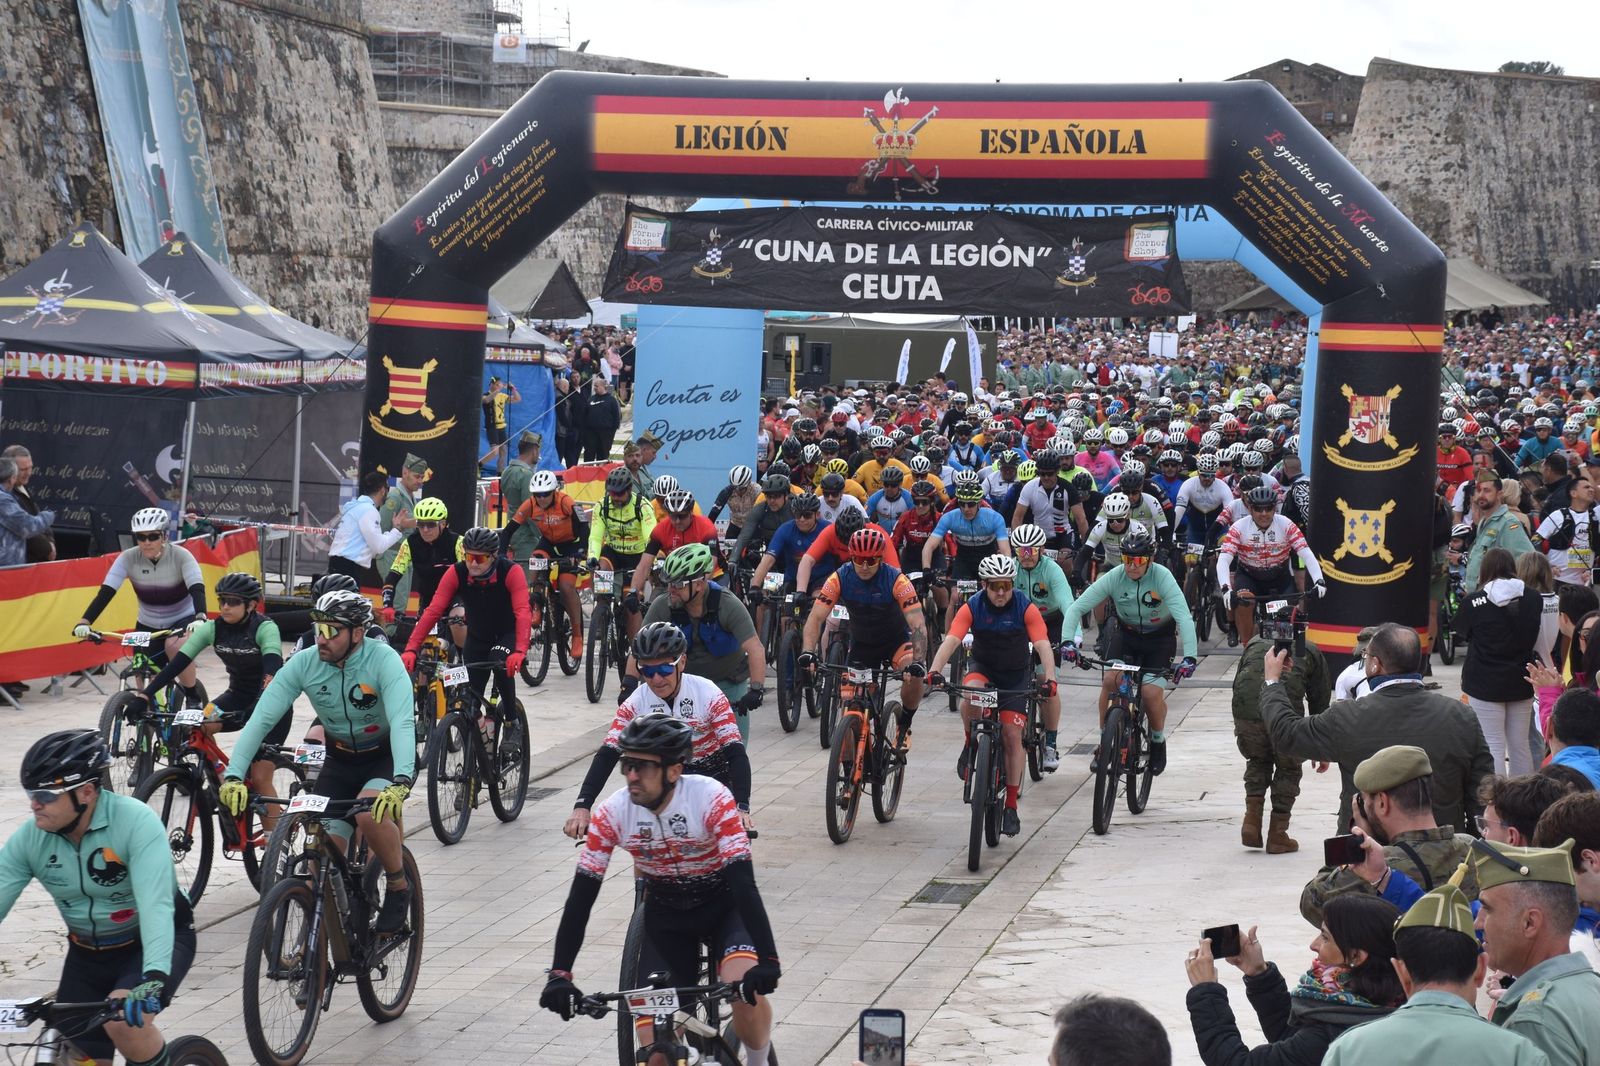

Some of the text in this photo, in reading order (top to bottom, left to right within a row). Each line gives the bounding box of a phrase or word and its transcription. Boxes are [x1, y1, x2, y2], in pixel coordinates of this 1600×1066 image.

[675, 119, 789, 151] LEGIÓN
[980, 122, 1148, 155] ESPAÑOLA
[412, 119, 539, 235] Espíritu del Legionario
[1264, 129, 1389, 253] Espíritu de la Muerte
[1131, 205, 1209, 222] CEUTA
[633, 221, 648, 230] The
[817, 216, 974, 232] CARRERA CÍVICO-MILITAR
[632, 230, 662, 238] Corner
[632, 238, 653, 246] Shop
[1135, 231, 1151, 239] The
[845, 240, 879, 265] DE
[888, 241, 922, 266] LA
[1133, 248, 1157, 256] Shop
[842, 273, 943, 301] CEUTA
[4, 350, 168, 386] EPORTIVO
[646, 380, 741, 407] Ceuta es
[648, 420, 742, 454] Deporte
[1472, 597, 1487, 607] HH
[451, 672, 467, 682] 593
[310, 750, 323, 760] 42
[304, 799, 323, 808] 132
[648, 995, 674, 1007] 129
